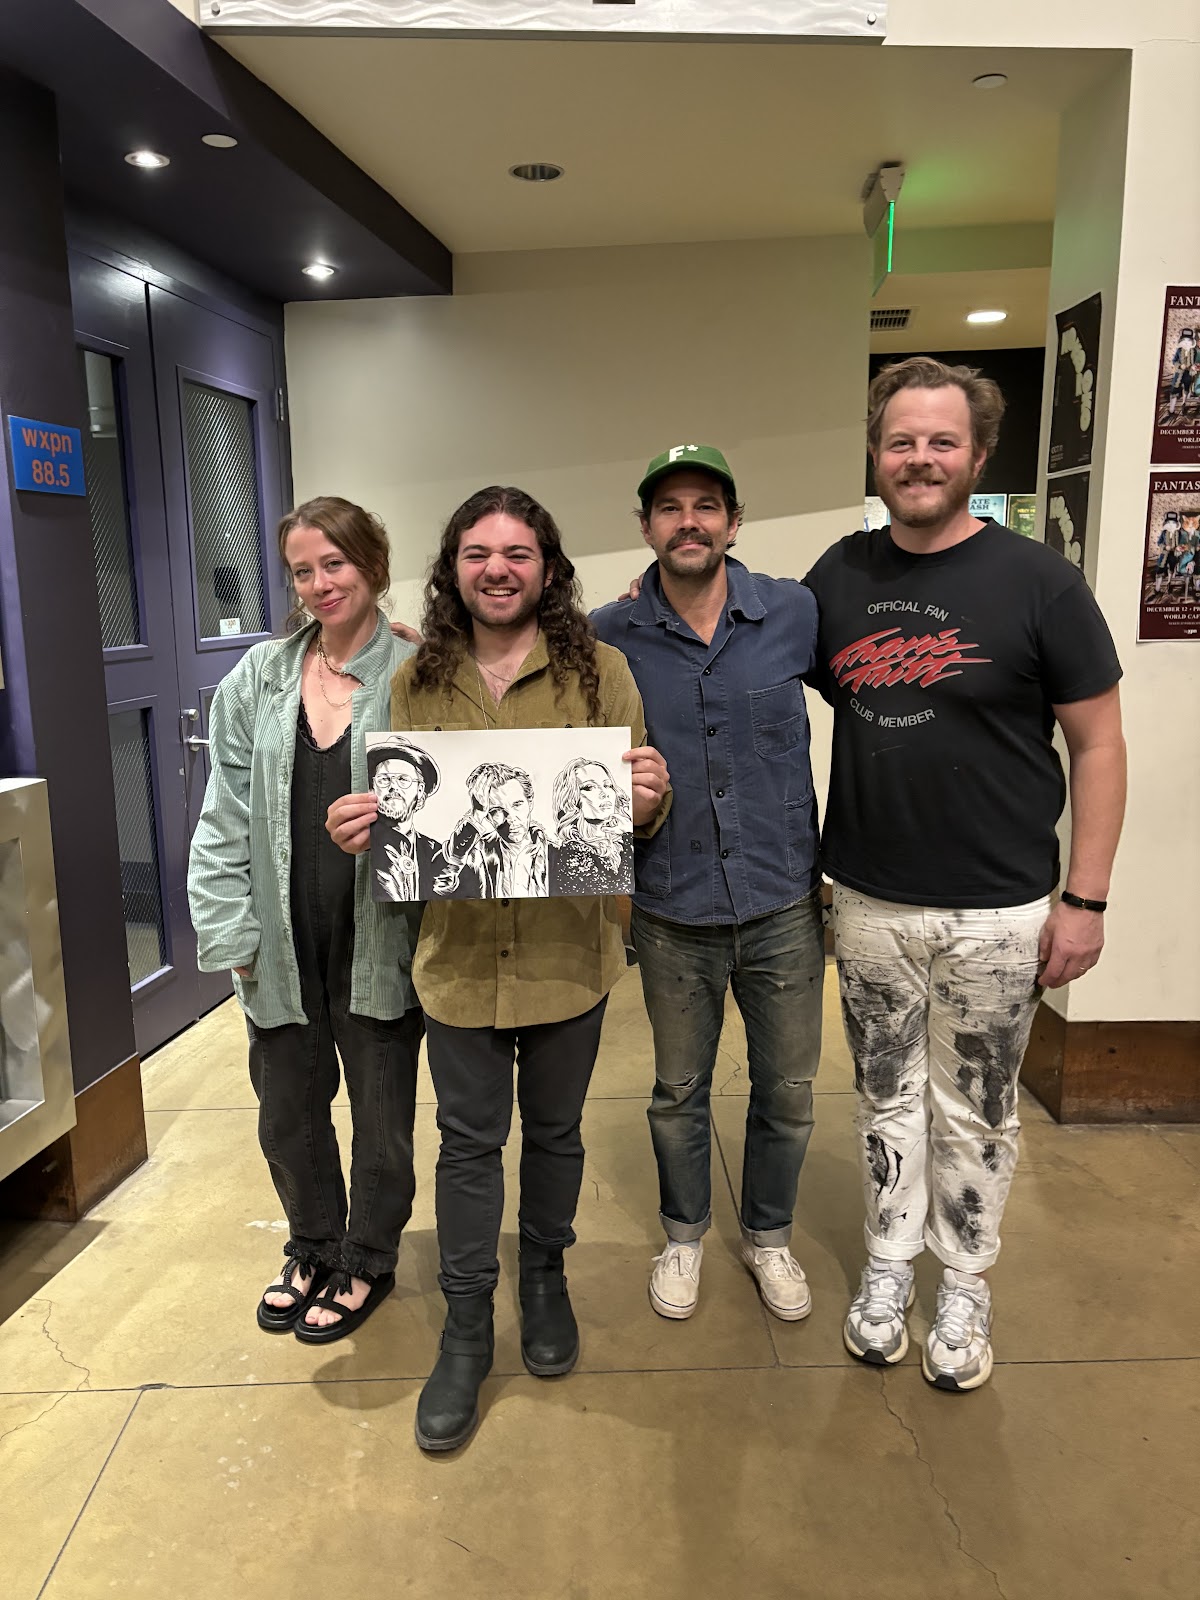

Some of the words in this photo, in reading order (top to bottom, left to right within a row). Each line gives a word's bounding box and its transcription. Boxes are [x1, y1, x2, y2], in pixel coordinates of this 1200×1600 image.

[22, 427, 72, 457] wxpn
[32, 459, 70, 487] 88.5
[867, 600, 920, 615] OFFICIAL
[924, 604, 949, 622] FAN
[850, 698, 874, 722] CLUB
[878, 708, 935, 728] MEMBER
